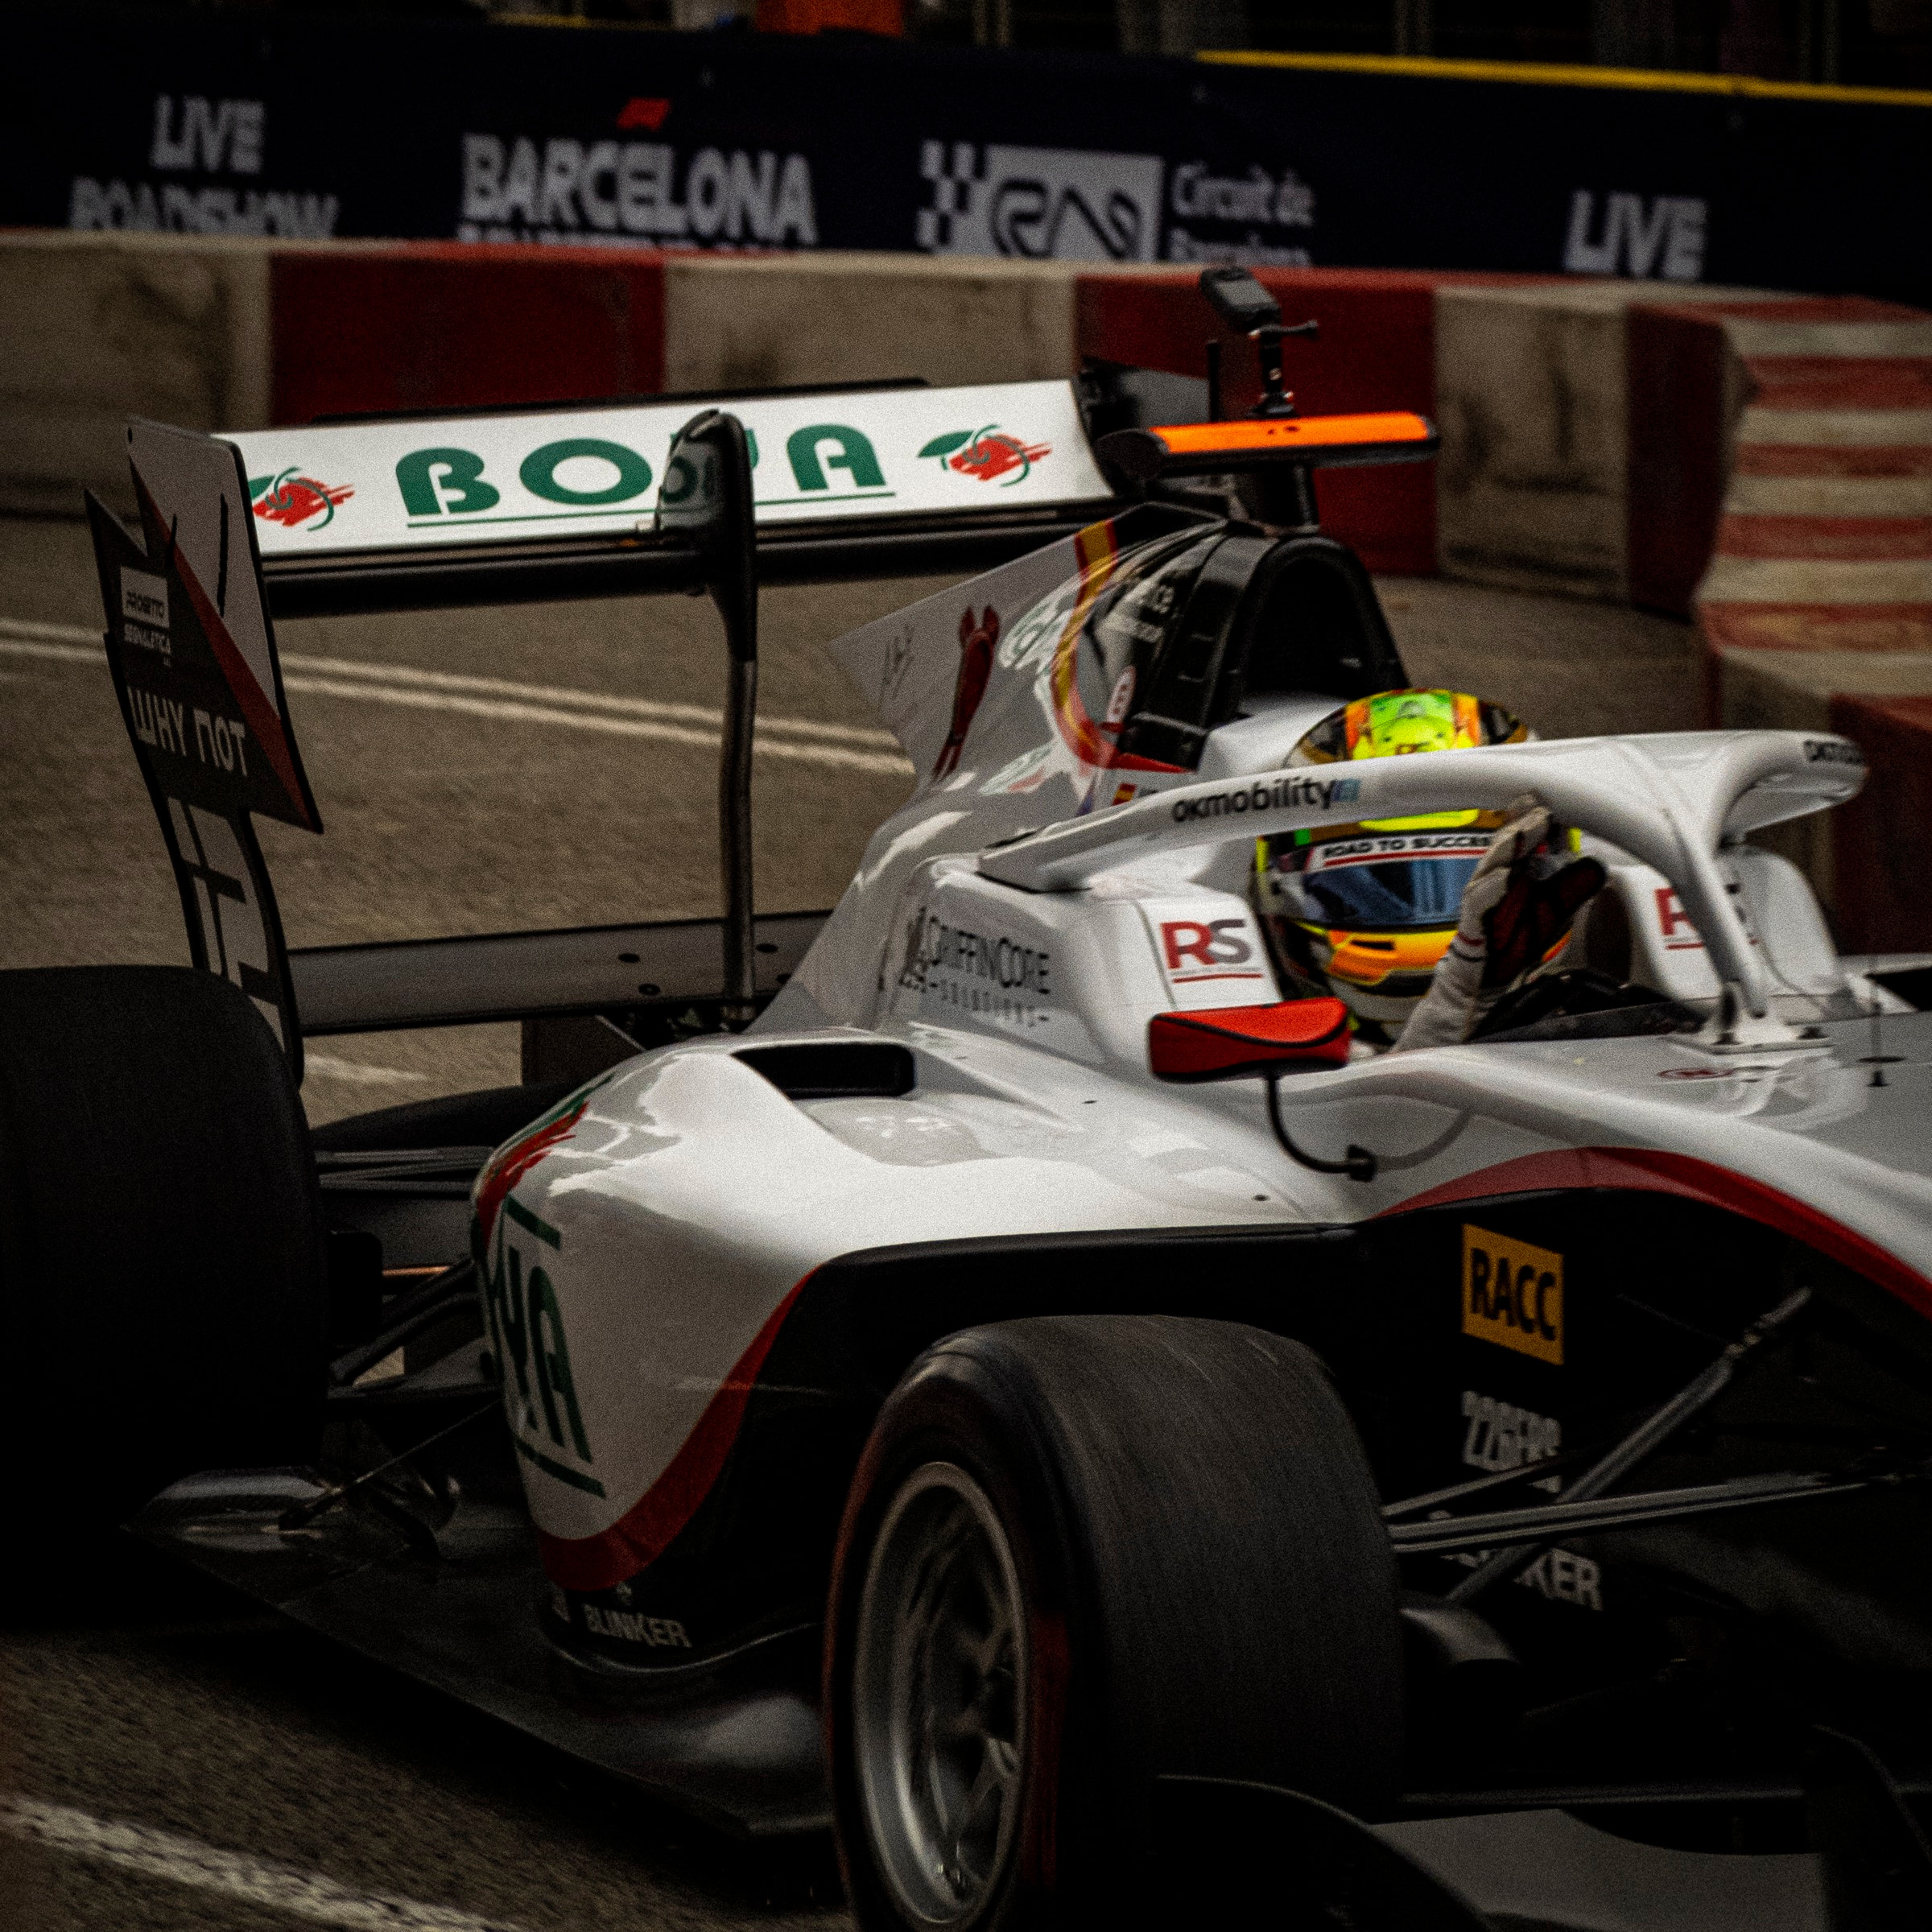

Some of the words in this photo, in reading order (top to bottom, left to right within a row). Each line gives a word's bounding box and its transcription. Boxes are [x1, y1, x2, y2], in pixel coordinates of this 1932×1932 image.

[151, 93, 265, 172] LIVE
[461, 133, 819, 246] BARCELONA
[1563, 188, 1708, 280] LIVE
[395, 424, 886, 517] BOA
[1380, 838, 1406, 851] TO
[1160, 919, 1252, 968] RS
[1472, 1249, 1556, 1340] RACC
[580, 1602, 692, 1648] BLINKER
